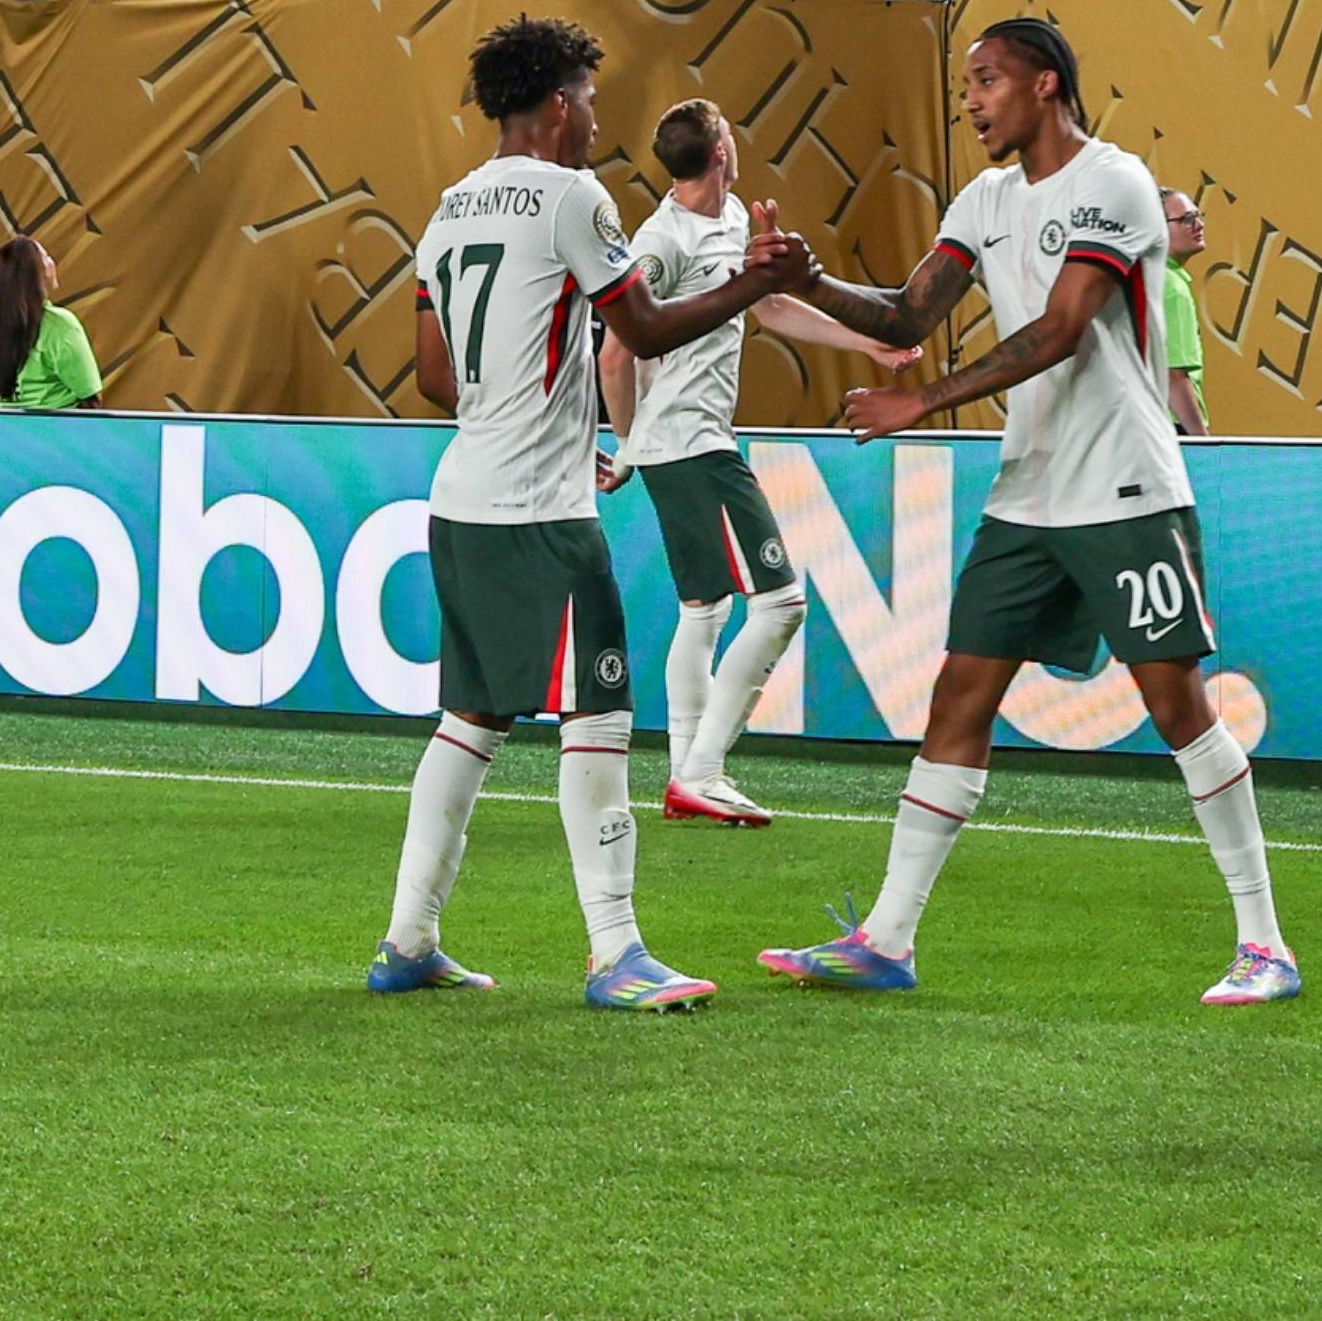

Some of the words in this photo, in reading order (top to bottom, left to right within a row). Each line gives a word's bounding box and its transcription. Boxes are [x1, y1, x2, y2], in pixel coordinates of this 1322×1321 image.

[473, 186, 544, 217] SANTOS
[436, 242, 505, 384] 17
[1116, 560, 1184, 629] 20
